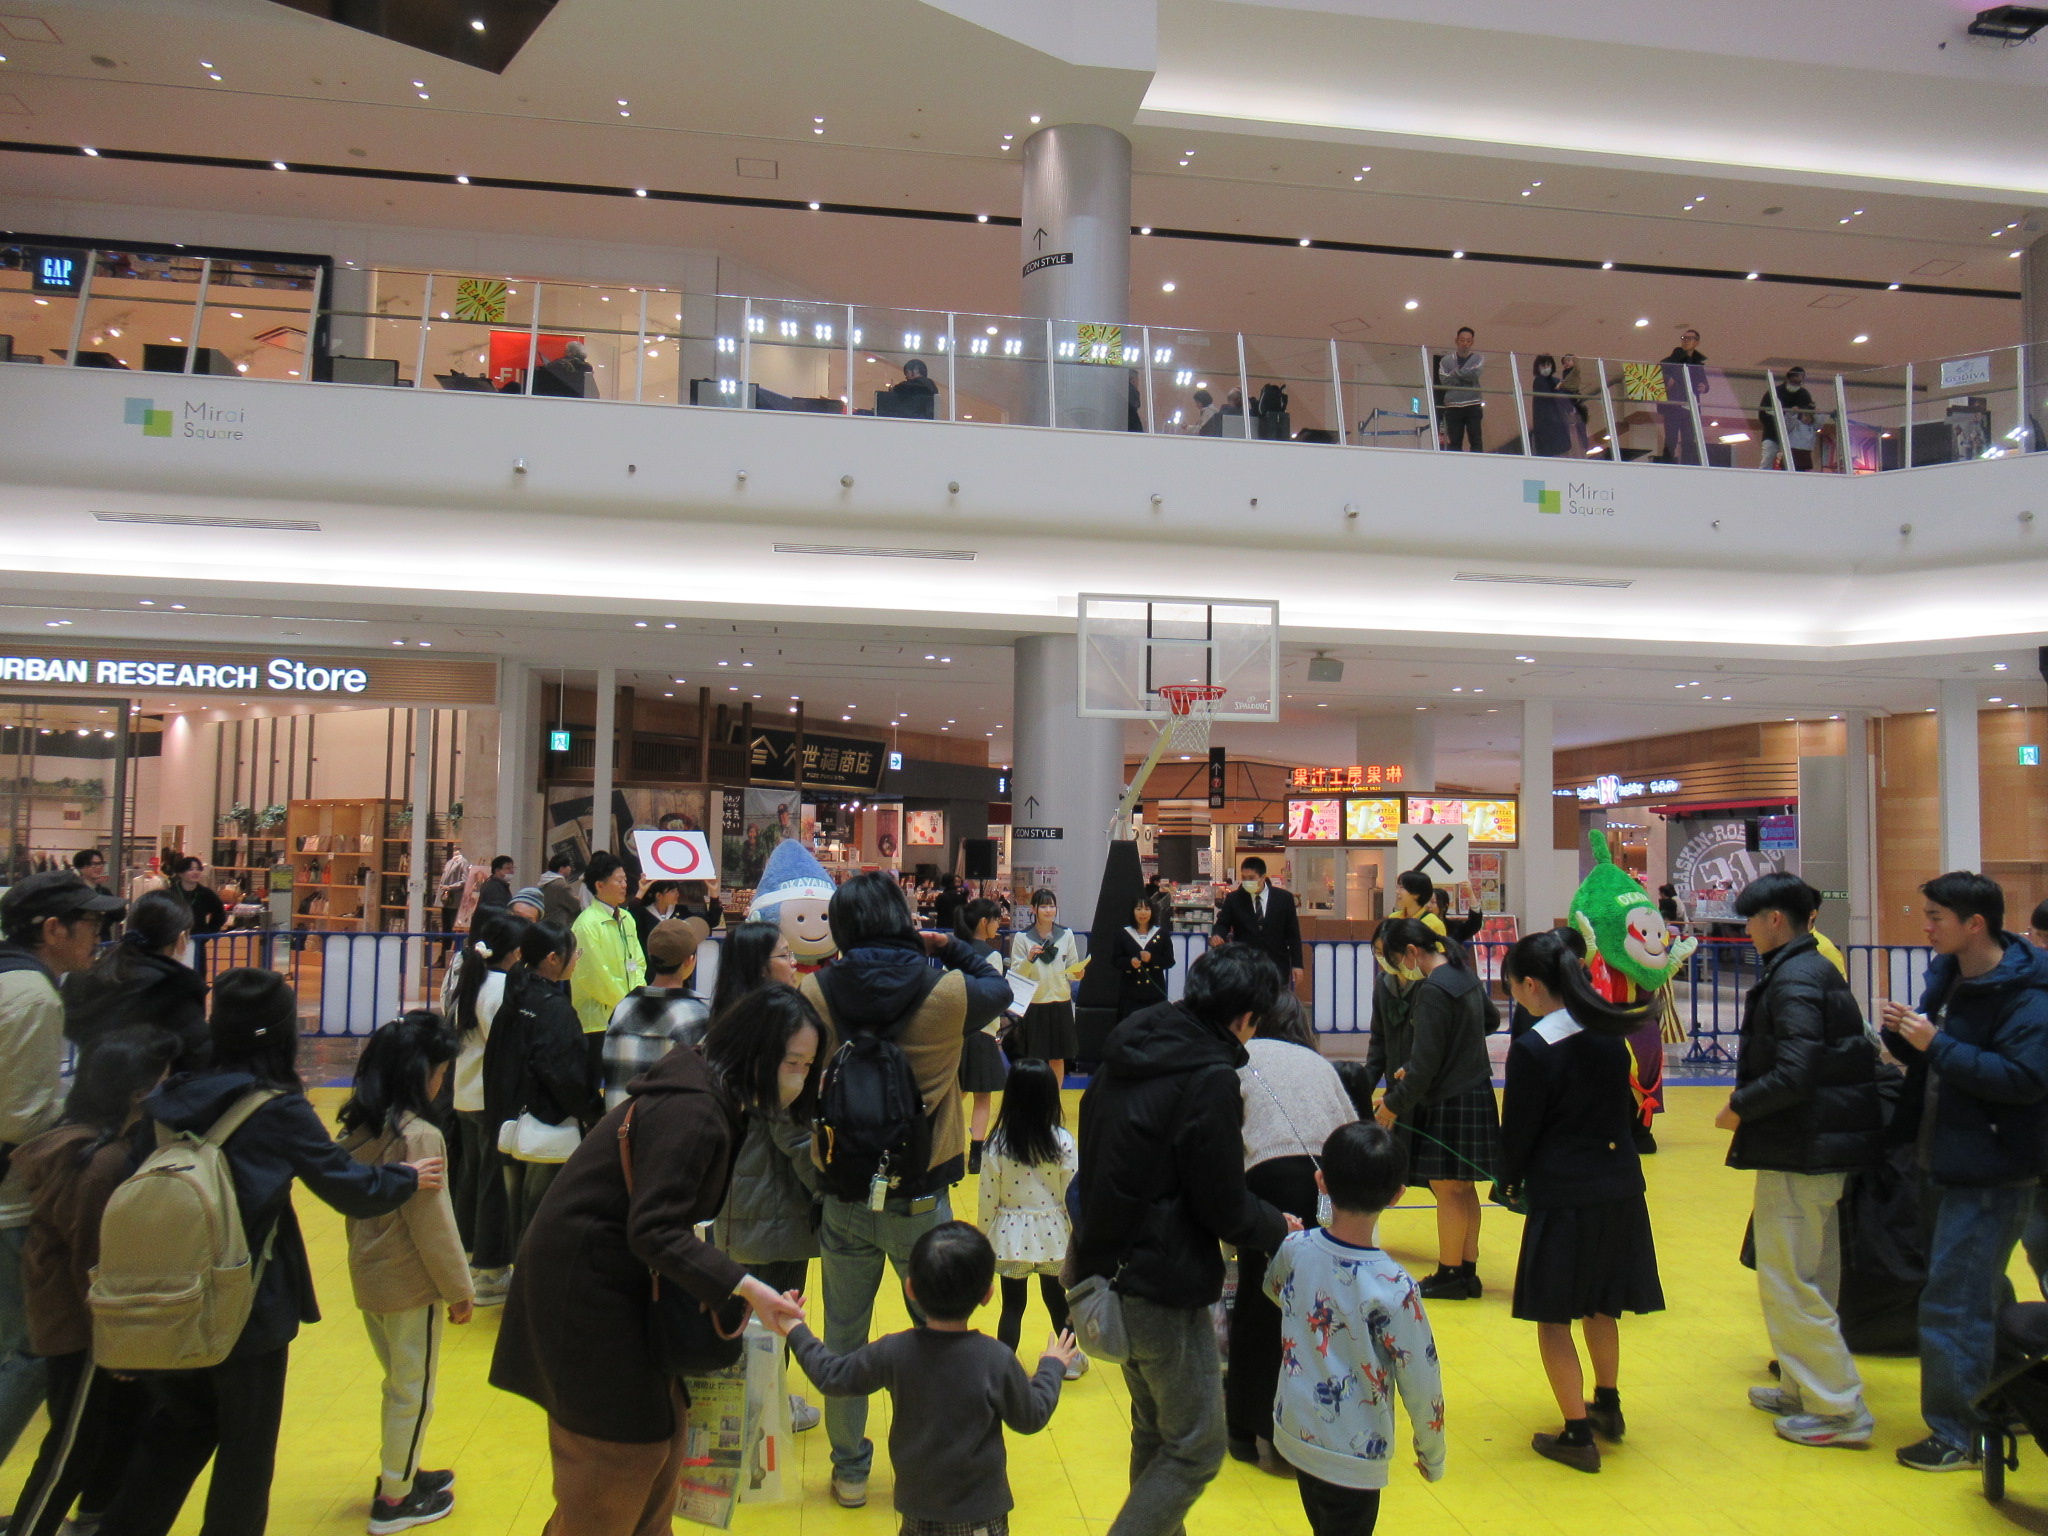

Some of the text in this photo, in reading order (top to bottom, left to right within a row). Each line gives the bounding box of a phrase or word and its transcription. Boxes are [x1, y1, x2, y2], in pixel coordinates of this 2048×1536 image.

[43, 258, 72, 278] GAP
[1041, 254, 1066, 267] STYLE
[459, 280, 501, 321] CLEARANCE
[1624, 365, 1666, 399] CLEARANCE
[1945, 372, 1985, 384] GODIVA
[183, 400, 244, 423] Mirai
[183, 421, 243, 441] Square
[1568, 482, 1614, 501] Mirai
[1568, 500, 1615, 517] Square
[0, 656, 368, 693] RBAN RESEARCH Store
[1234, 701, 1268, 711] SPALDING
[1294, 765, 1403, 786] 果汁工房果琳
[1030, 829, 1056, 838] STYLE
[780, 876, 832, 890] OKAYAMA
[1823, 891, 1848, 899] 非常口
